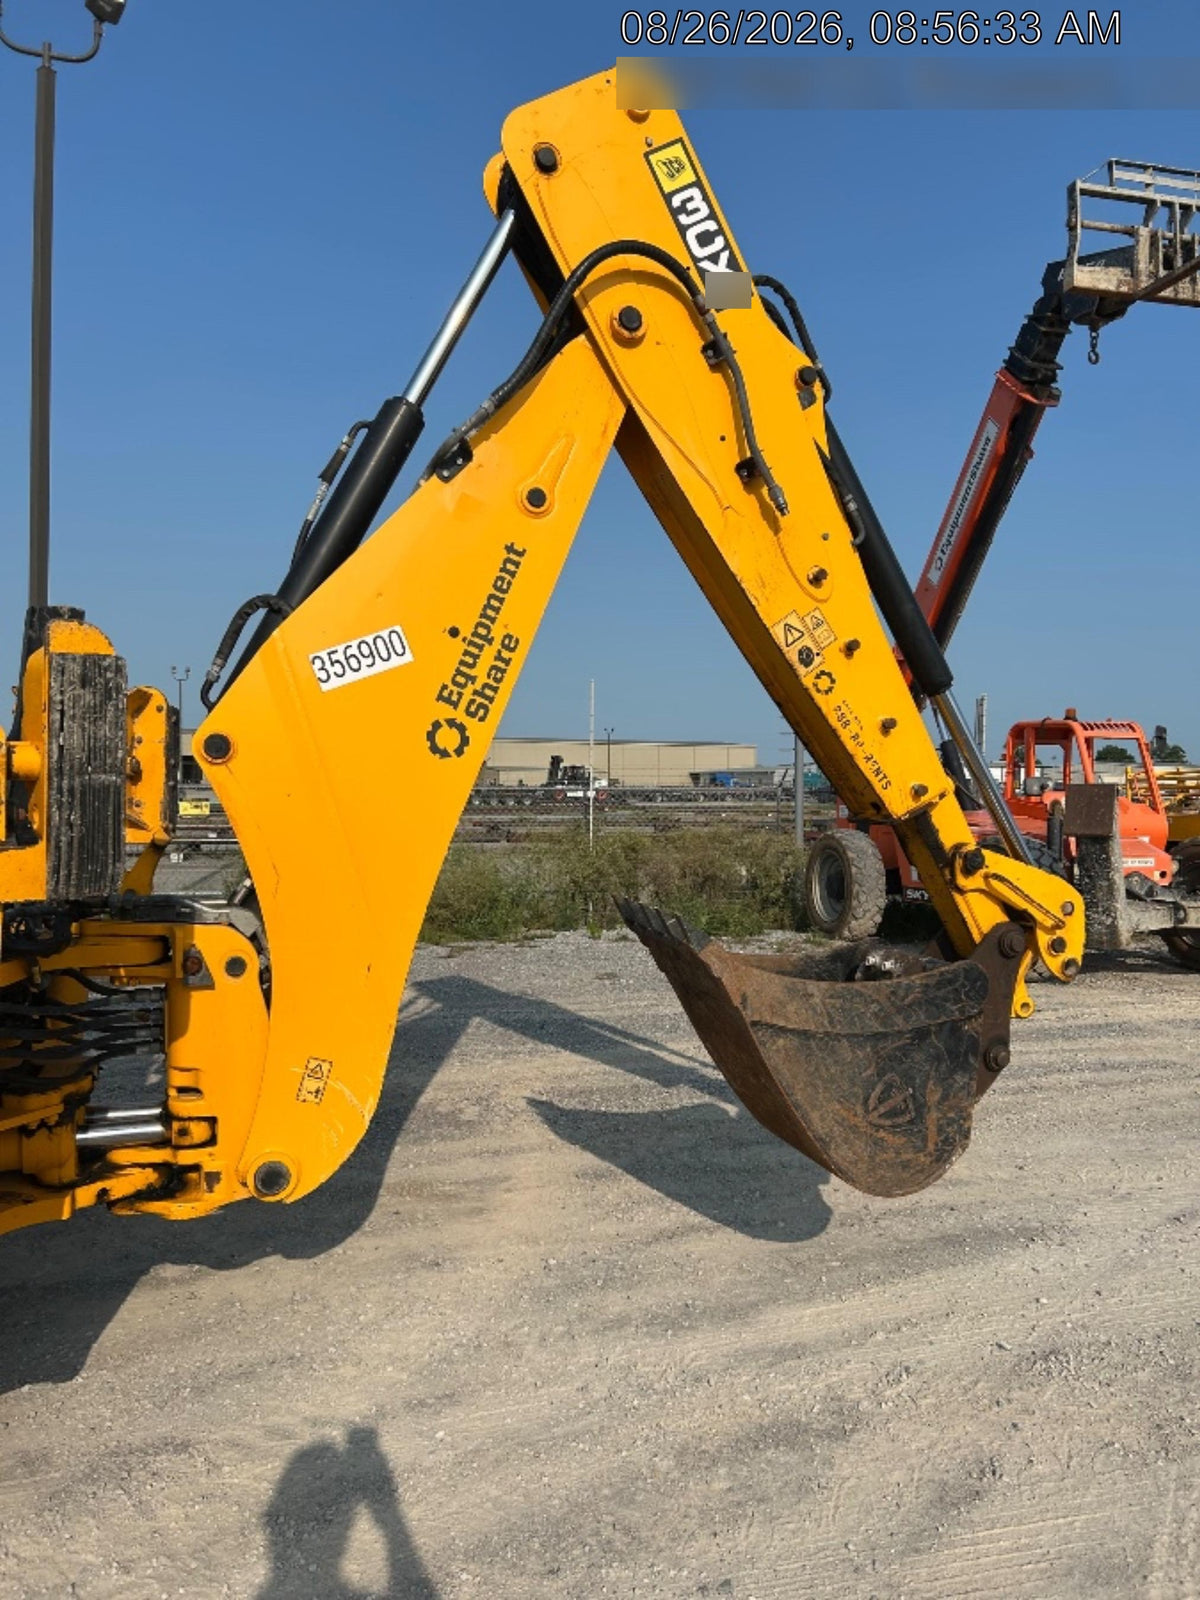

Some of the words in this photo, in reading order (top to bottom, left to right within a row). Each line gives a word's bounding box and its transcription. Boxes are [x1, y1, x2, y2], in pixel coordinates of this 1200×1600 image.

[311, 629, 406, 683] 356900
[435, 542, 527, 712] Equipment
[464, 632, 520, 722] Share
